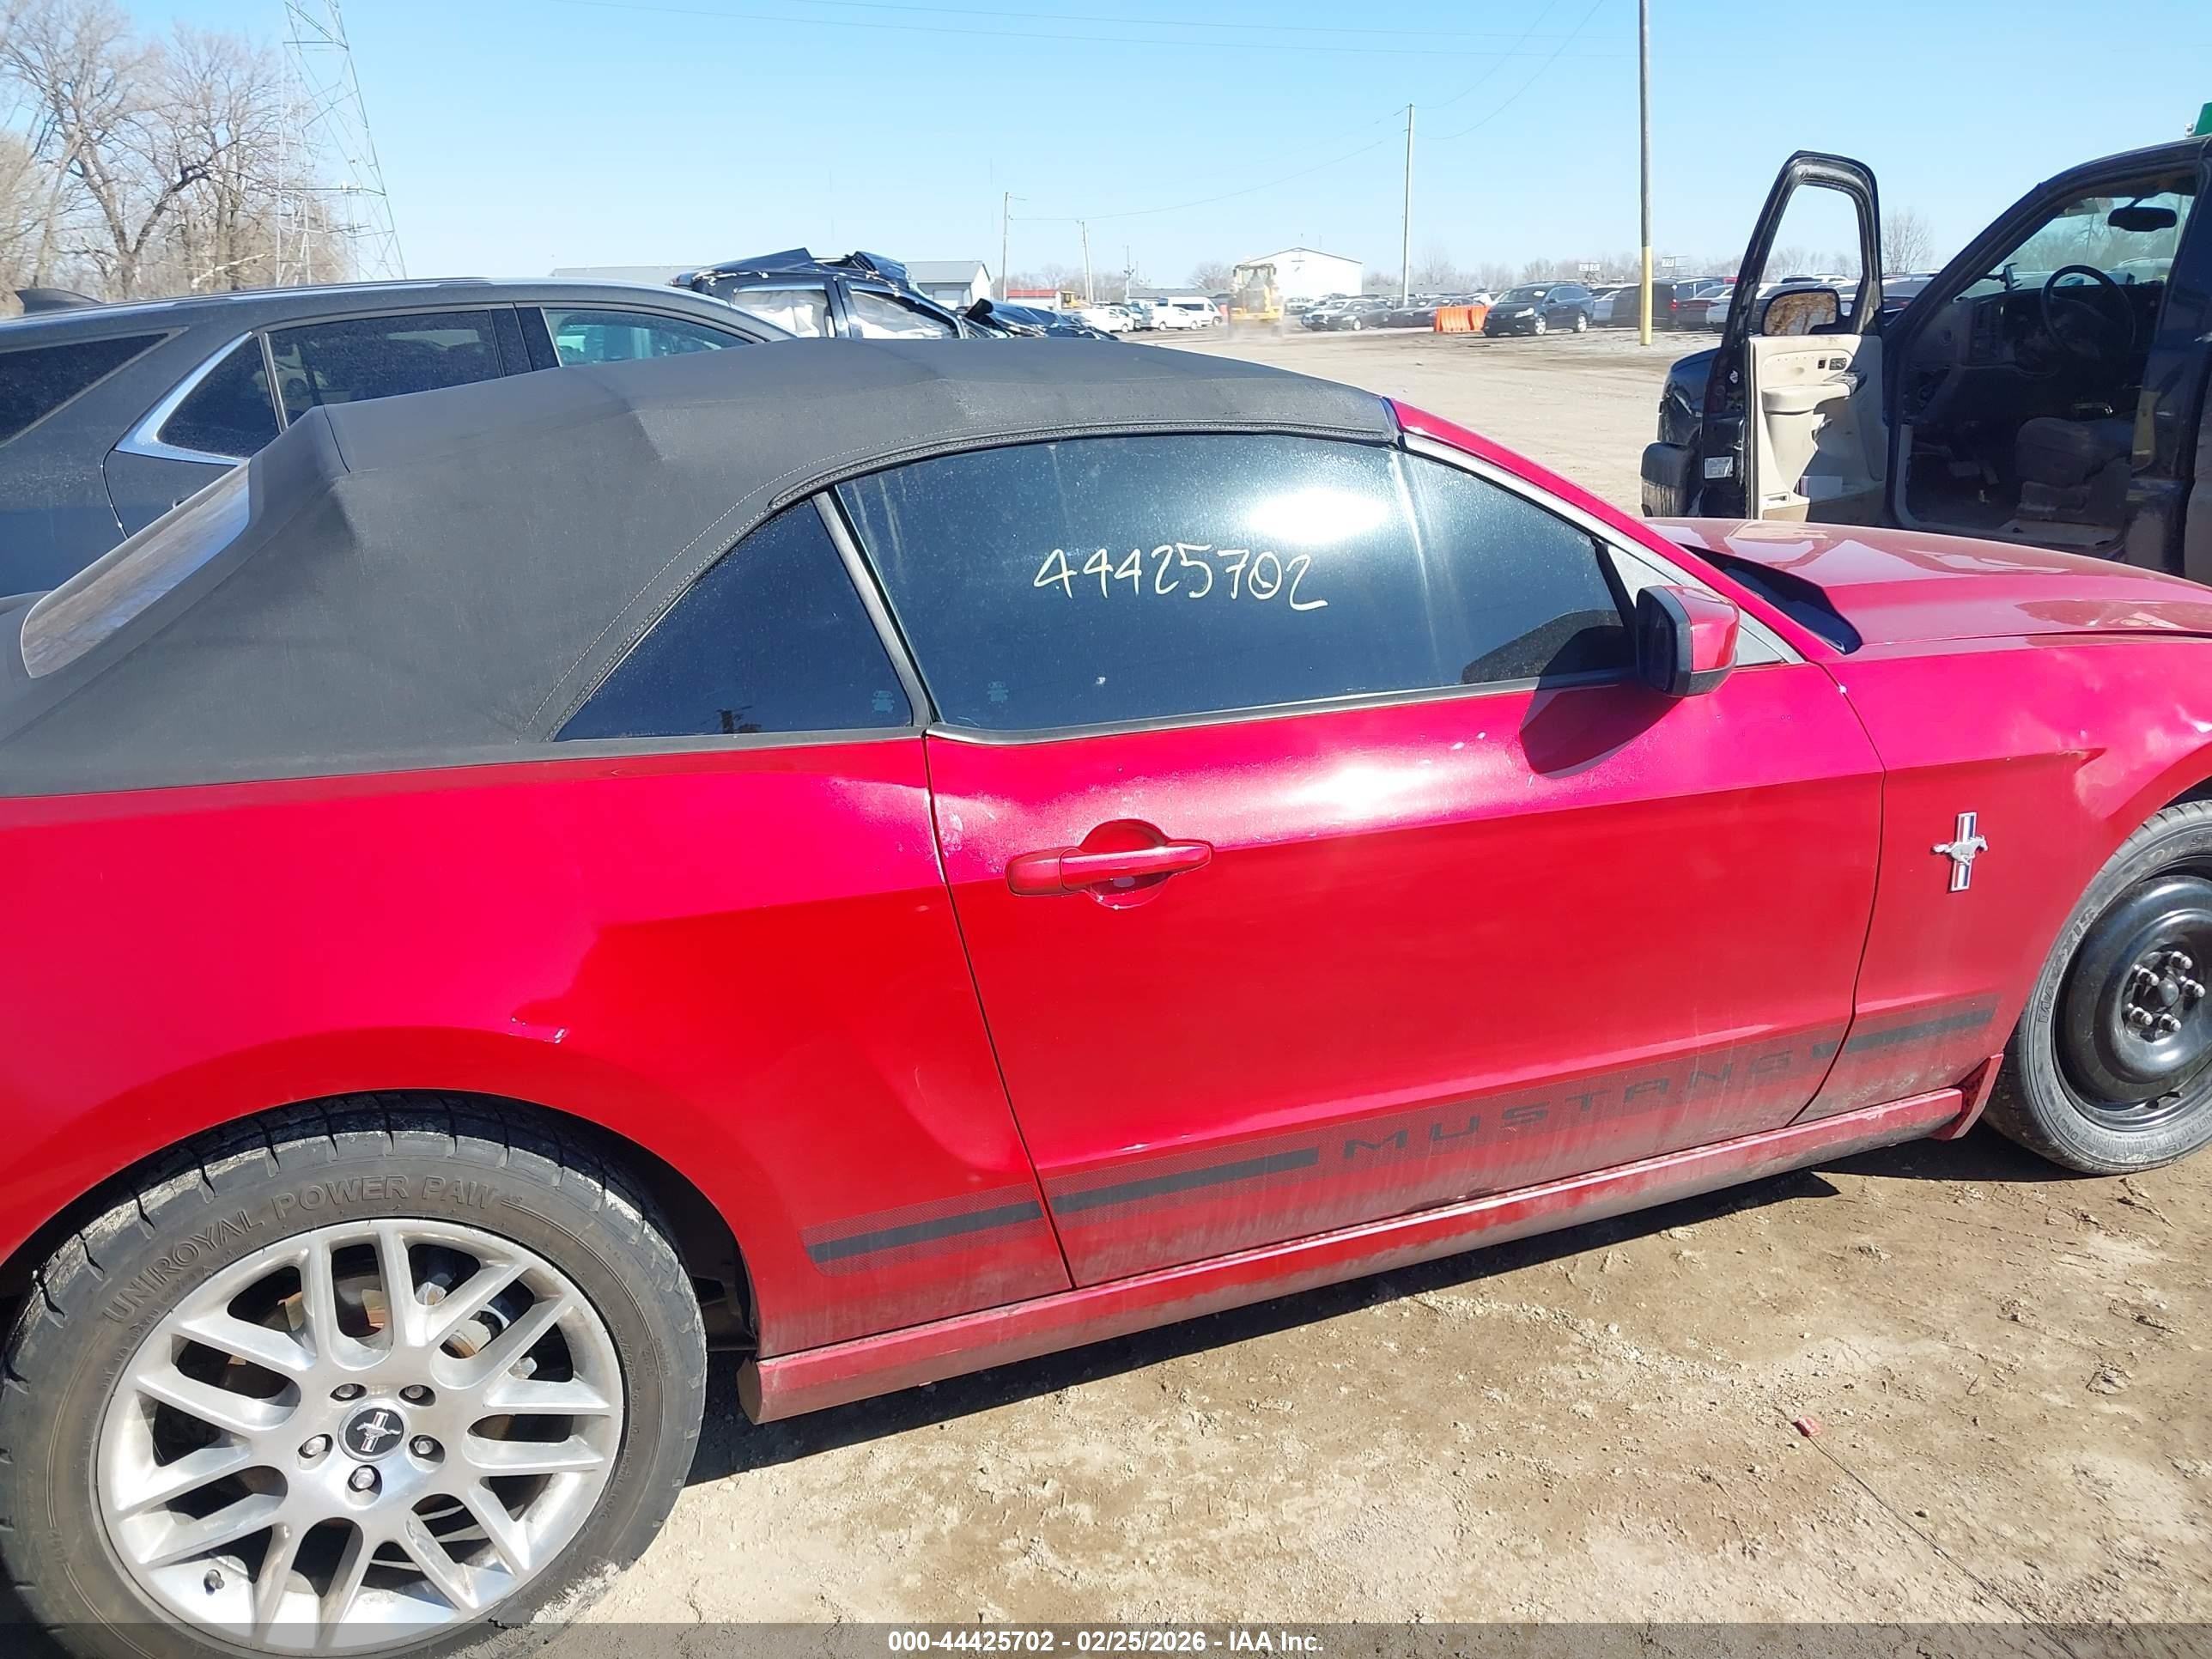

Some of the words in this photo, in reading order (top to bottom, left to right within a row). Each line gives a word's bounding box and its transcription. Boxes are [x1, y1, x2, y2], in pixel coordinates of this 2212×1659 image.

[1033, 543, 1328, 611] 44425702
[1343, 1050, 1792, 1160] MUSTANG
[102, 1209, 264, 1323] UNIROYAL
[270, 1175, 410, 1220] POWER
[422, 1175, 496, 1209] PAW
